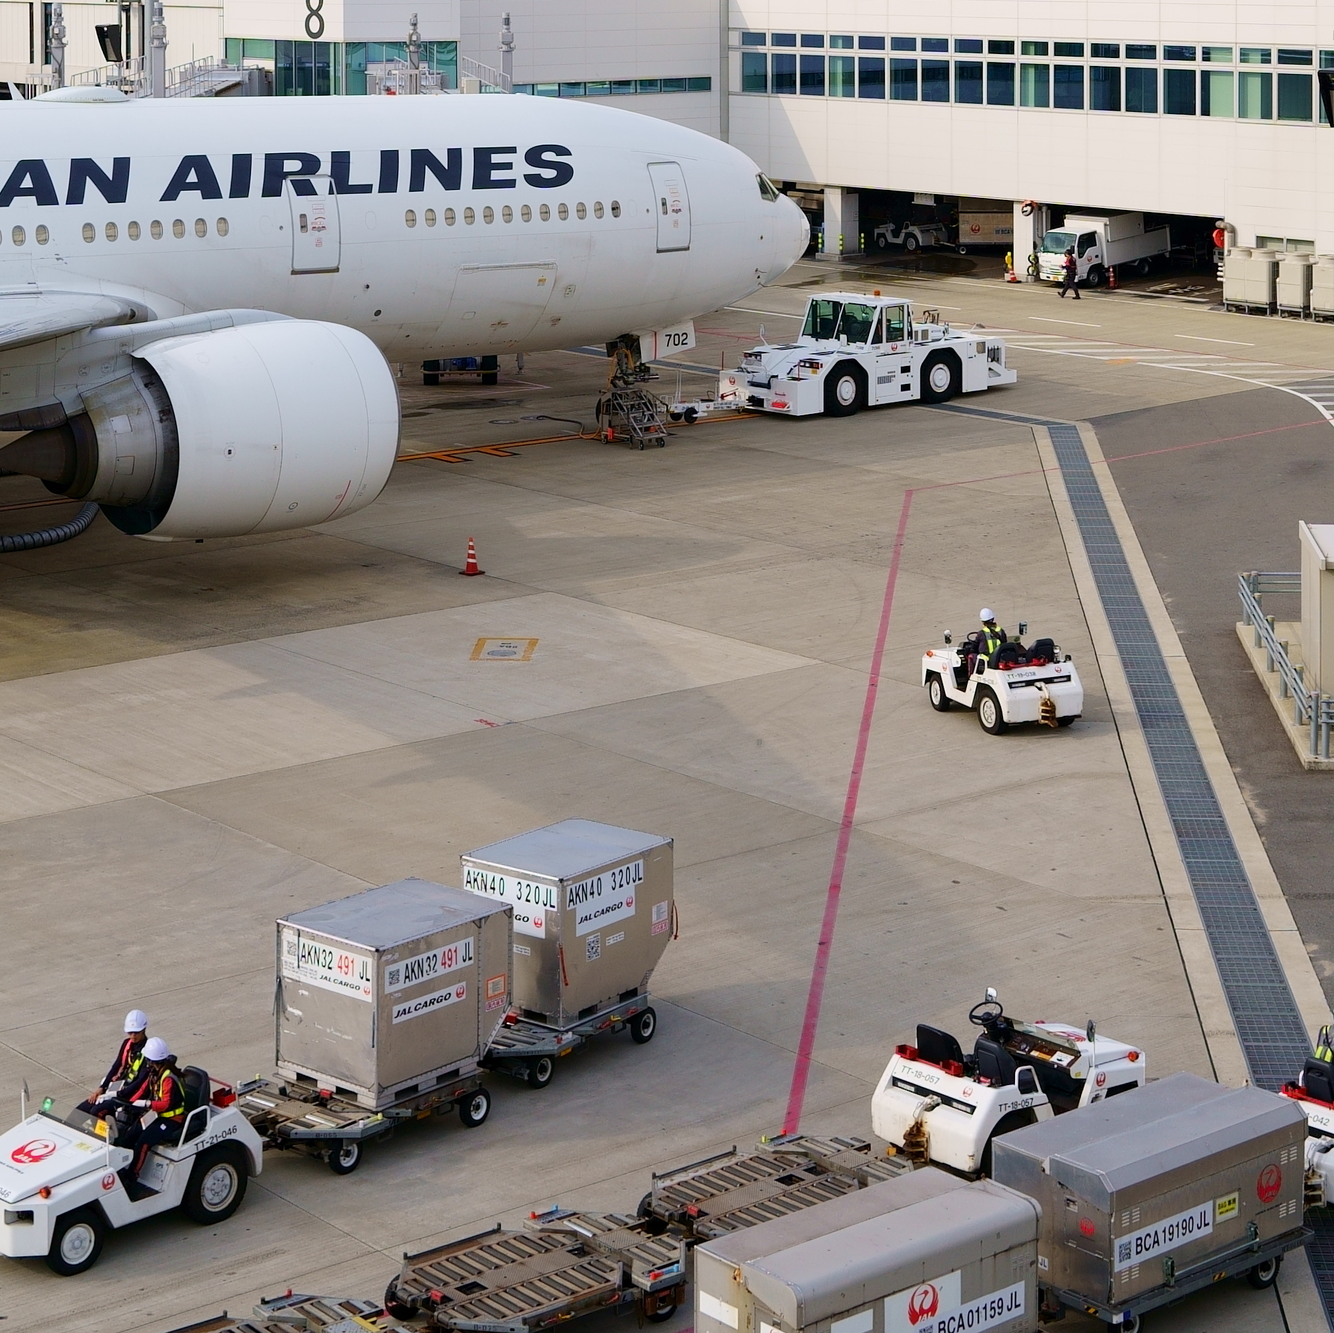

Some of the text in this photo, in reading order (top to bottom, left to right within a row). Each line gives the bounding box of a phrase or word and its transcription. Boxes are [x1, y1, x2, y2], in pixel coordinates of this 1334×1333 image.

[160, 143, 575, 201] AIRLINES
[665, 332, 688, 347] 702
[465, 869, 505, 896] AKN40
[567, 877, 602, 908] AKN40
[300, 942, 334, 970] AKN32
[337, 954, 355, 977] 491
[359, 960, 370, 982] JL
[403, 941, 473, 985] AKN32 491 JL
[901, 1064, 940, 1085] TT-18-057
[998, 1097, 1034, 1113] TT-18-057
[194, 1124, 239, 1153] TT-21-046
[1196, 1209, 1210, 1231] JL
[1038, 1256, 1048, 1268] JL
[1006, 1290, 1021, 1312] JL
